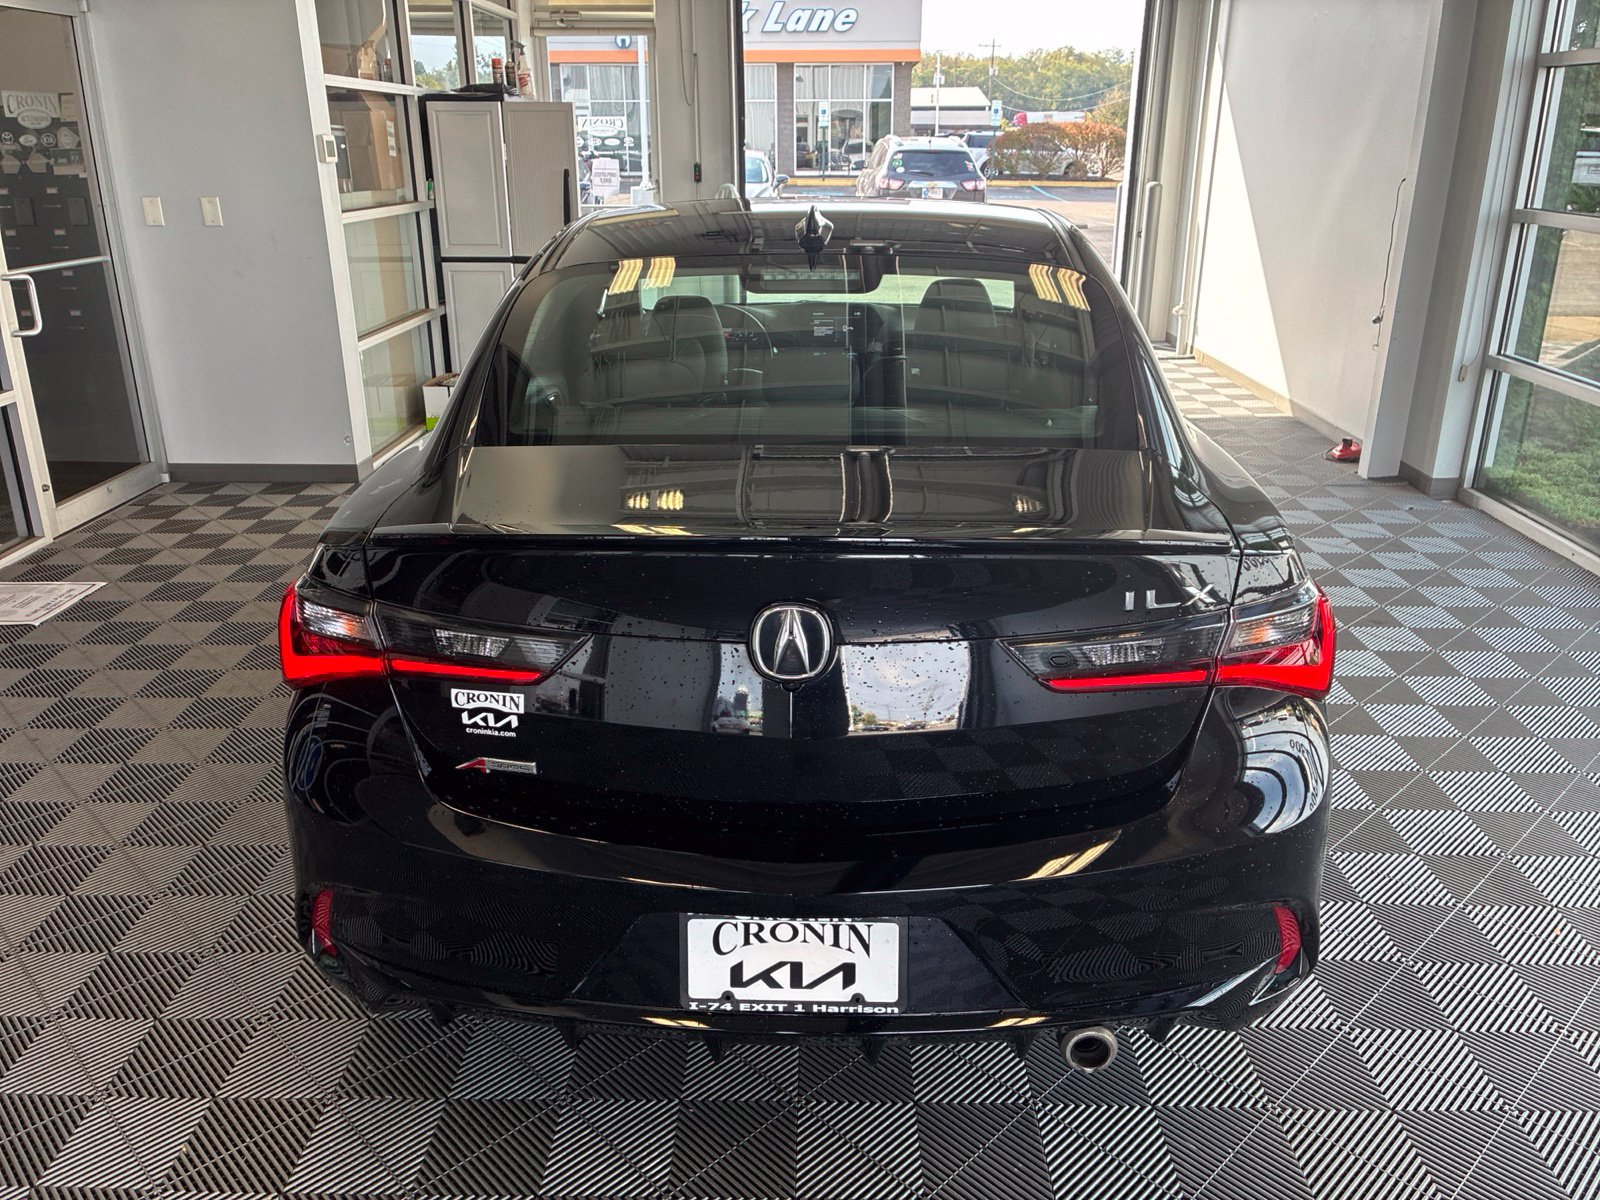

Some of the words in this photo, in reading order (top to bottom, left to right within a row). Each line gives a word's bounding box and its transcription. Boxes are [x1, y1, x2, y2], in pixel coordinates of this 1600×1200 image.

[761, 0, 859, 33] Lane
[7, 94, 57, 115] CRONIN
[1125, 583, 1217, 611] ILX
[454, 690, 521, 712] CRONIN
[461, 710, 519, 729] KIA
[465, 727, 517, 738] croninkia.com
[712, 920, 875, 959] CRONIN
[729, 959, 857, 991] KIA
[688, 1002, 733, 1011] I-74
[739, 1003, 788, 1012] EXIT
[794, 1004, 806, 1012] 1
[812, 1004, 899, 1014] Harrison
